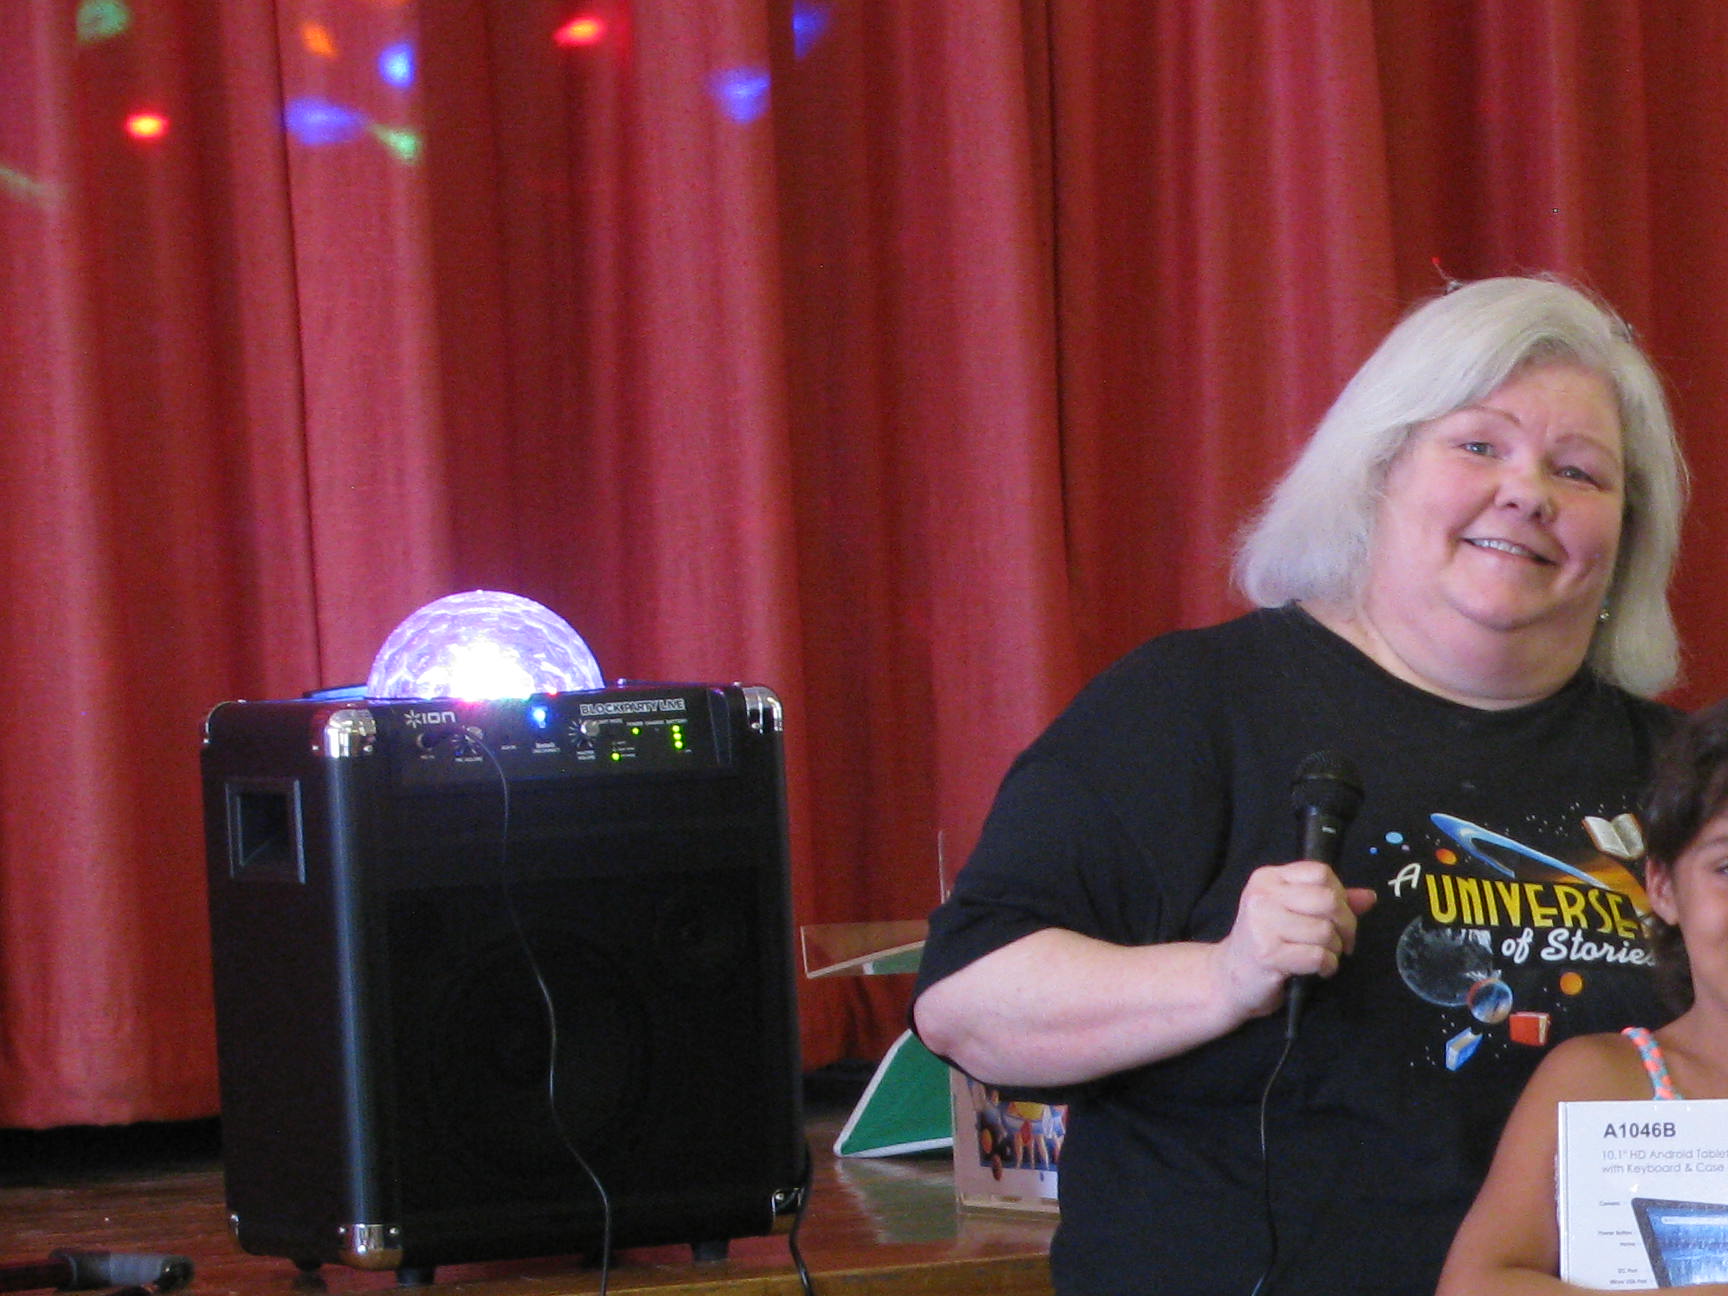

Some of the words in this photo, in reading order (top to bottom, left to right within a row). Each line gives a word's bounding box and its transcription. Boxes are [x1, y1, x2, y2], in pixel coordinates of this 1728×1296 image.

[580, 701, 621, 716] BLOCK
[621, 699, 659, 714] PARTY
[660, 697, 687, 711] LIVE
[1387, 862, 1421, 897] A
[1424, 873, 1637, 940] UNIVERSE
[1501, 927, 1535, 964] of
[1603, 1122, 1677, 1139] A1046B
[1629, 1149, 1646, 1160] HD
[1649, 1149, 1693, 1160] Android
[1602, 1164, 1624, 1174] with
[1627, 1163, 1681, 1175] Keyboard
[1695, 1162, 1725, 1173] Case
